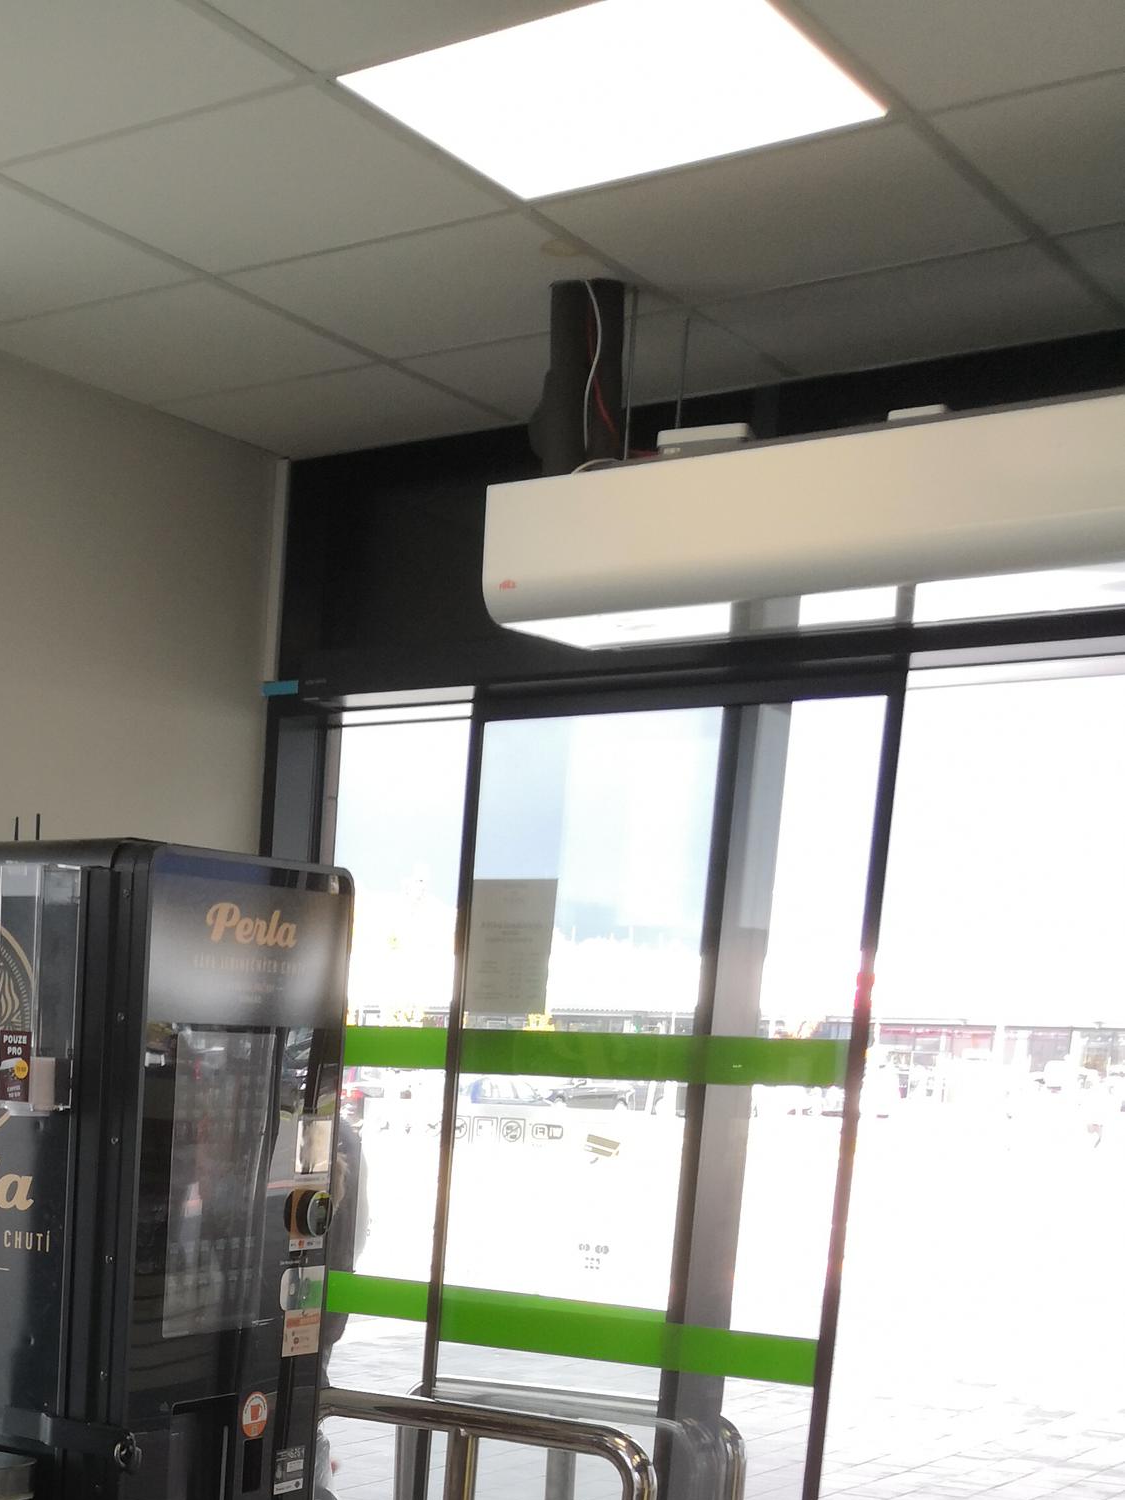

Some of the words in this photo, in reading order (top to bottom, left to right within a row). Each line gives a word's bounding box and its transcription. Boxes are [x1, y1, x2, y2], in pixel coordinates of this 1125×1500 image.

[206, 902, 297, 948] Perla
[3, 1034, 28, 1045] POUZE
[7, 1046, 23, 1056] PRO
[4, 1230, 51, 1253] CHUTÍ
